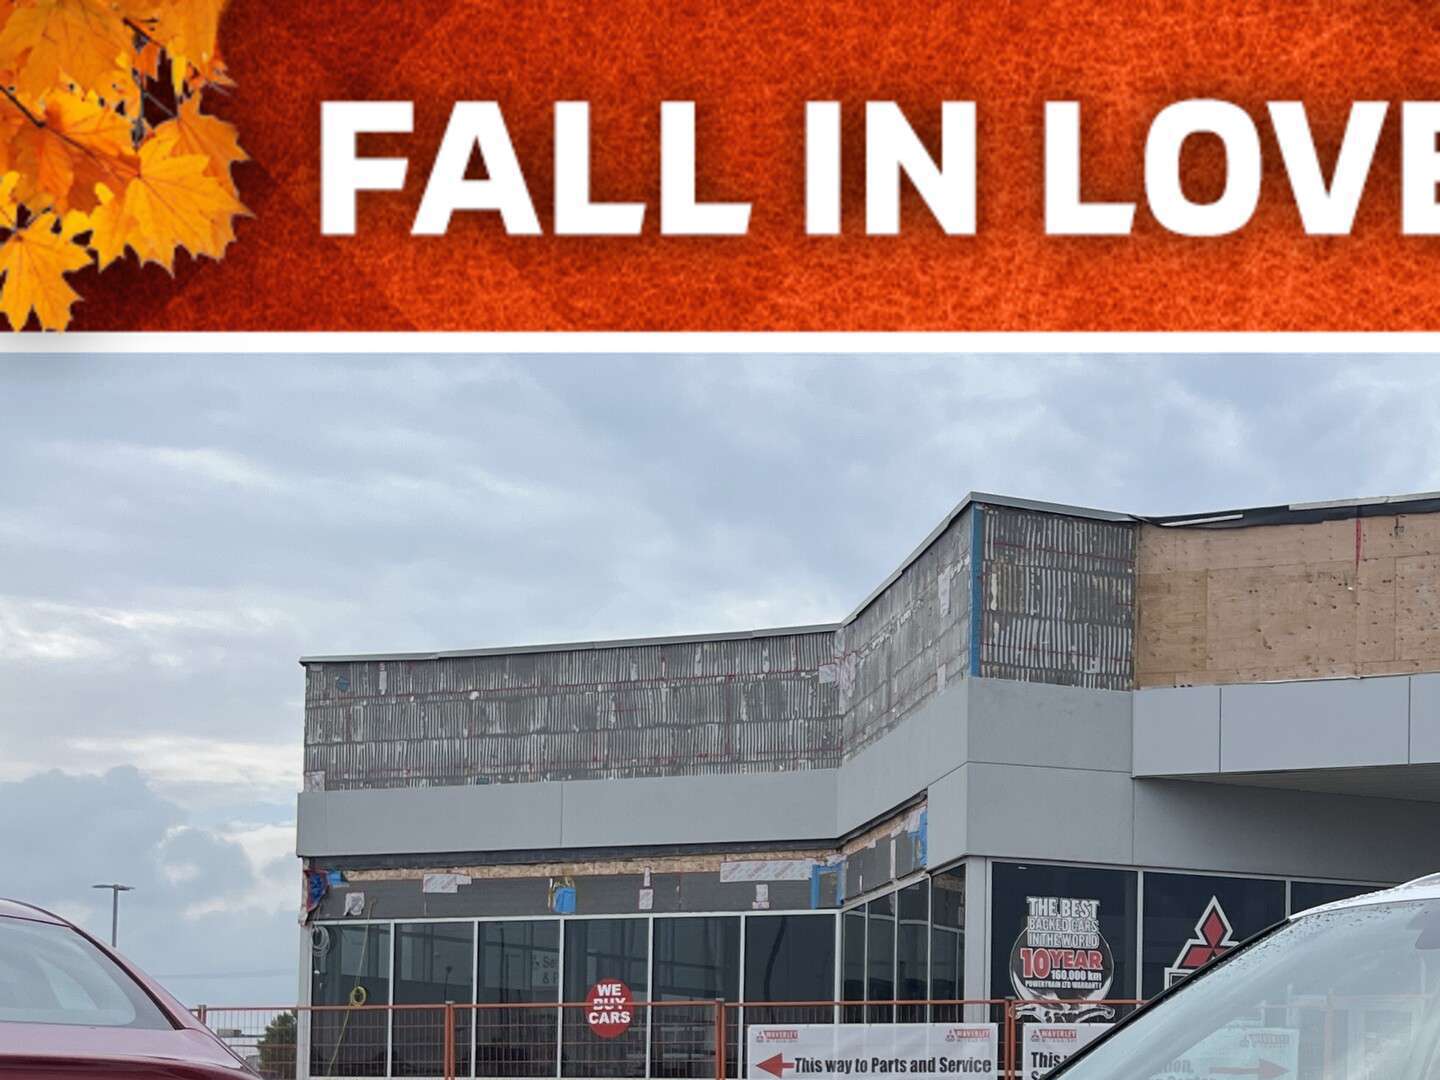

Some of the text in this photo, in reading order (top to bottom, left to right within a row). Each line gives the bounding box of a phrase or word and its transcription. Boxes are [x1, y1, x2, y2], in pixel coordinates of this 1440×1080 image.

[1027, 896, 1100, 920] THE BEST
[1029, 917, 1099, 932] BACKED CARS
[1041, 932, 1061, 947] THE
[1062, 933, 1099, 949] WORLD
[1020, 948, 1103, 979] 10 YEAR
[597, 984, 622, 996] WE
[593, 997, 626, 1011] BUY
[589, 1011, 631, 1025] CARS
[794, 1057, 992, 1074] This way to Parts and Service
[1031, 1052, 1060, 1068] This
